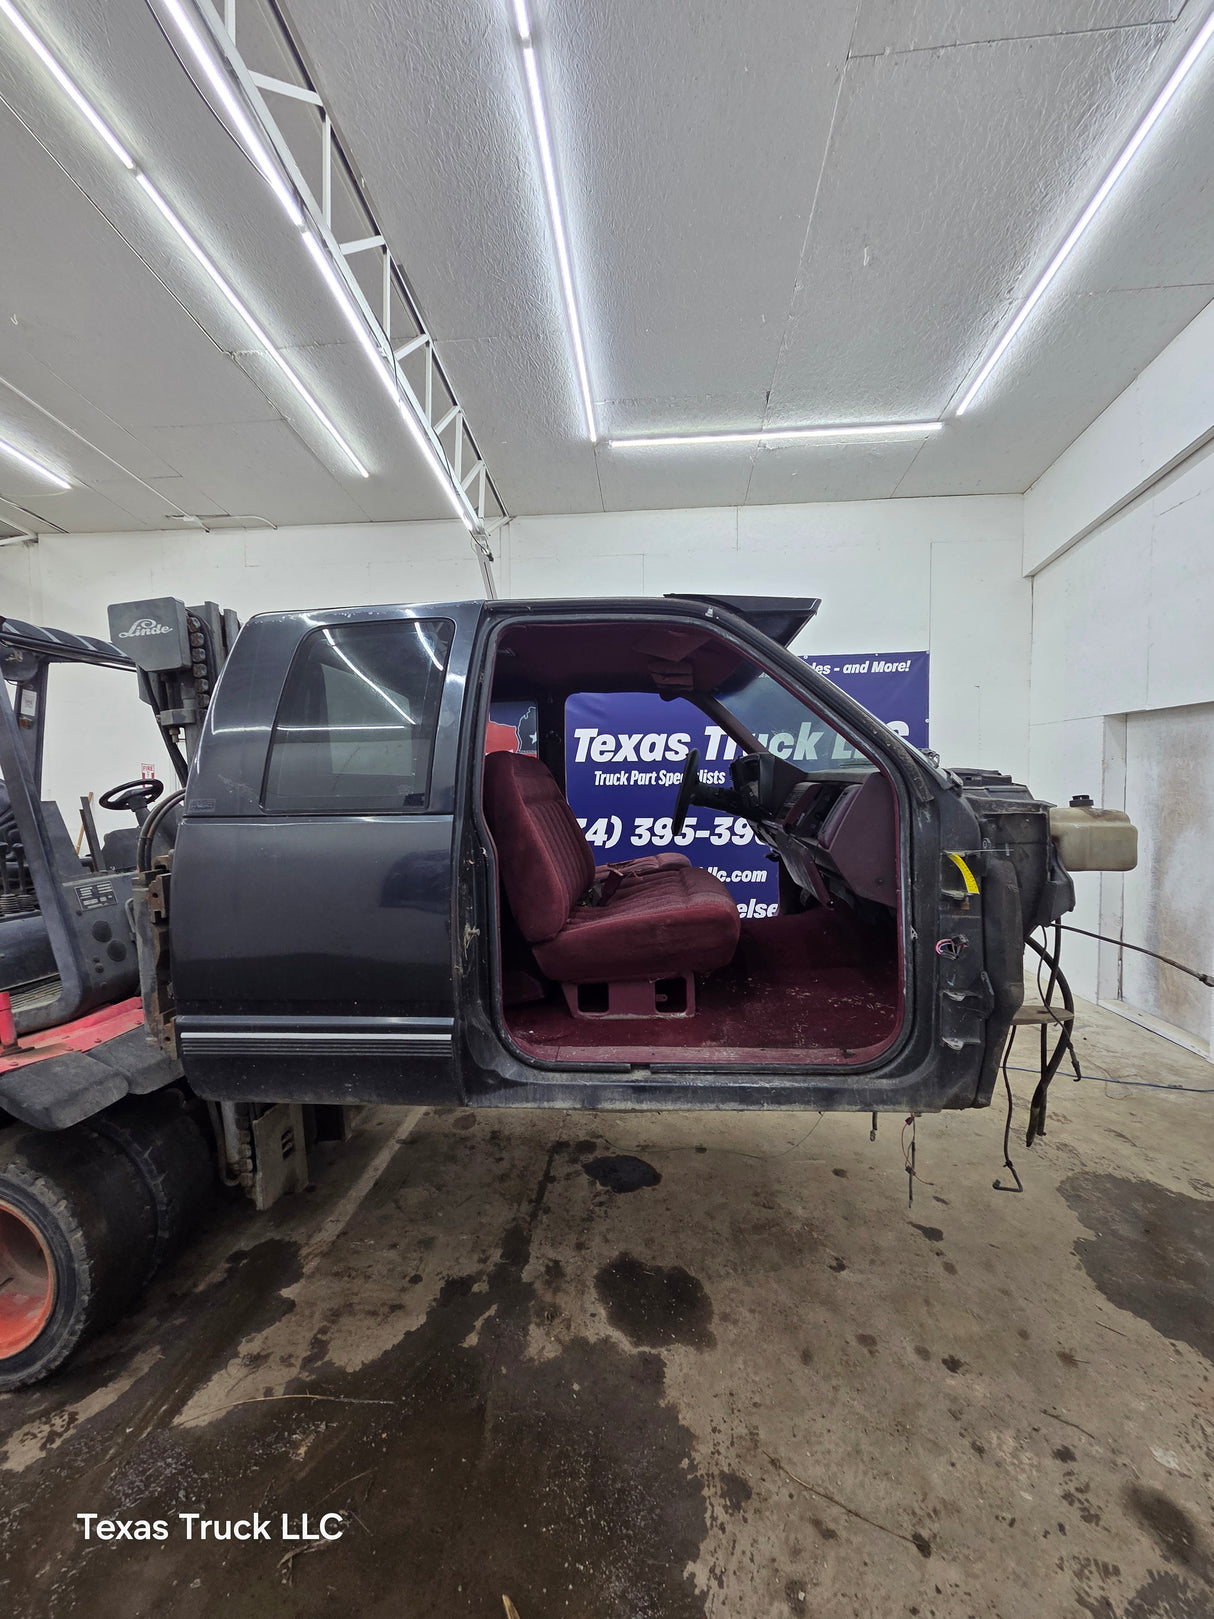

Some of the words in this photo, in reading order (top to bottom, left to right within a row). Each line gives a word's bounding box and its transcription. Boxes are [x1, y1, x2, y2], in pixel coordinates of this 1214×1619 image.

[118, 618, 173, 638] Linde
[842, 660, 869, 674] and
[870, 660, 911, 673] More!
[573, 728, 691, 762] Texas
[704, 721, 824, 760] Trck
[594, 770, 630, 786] Truck
[630, 769, 657, 785] Part
[631, 816, 766, 846] 395-39
